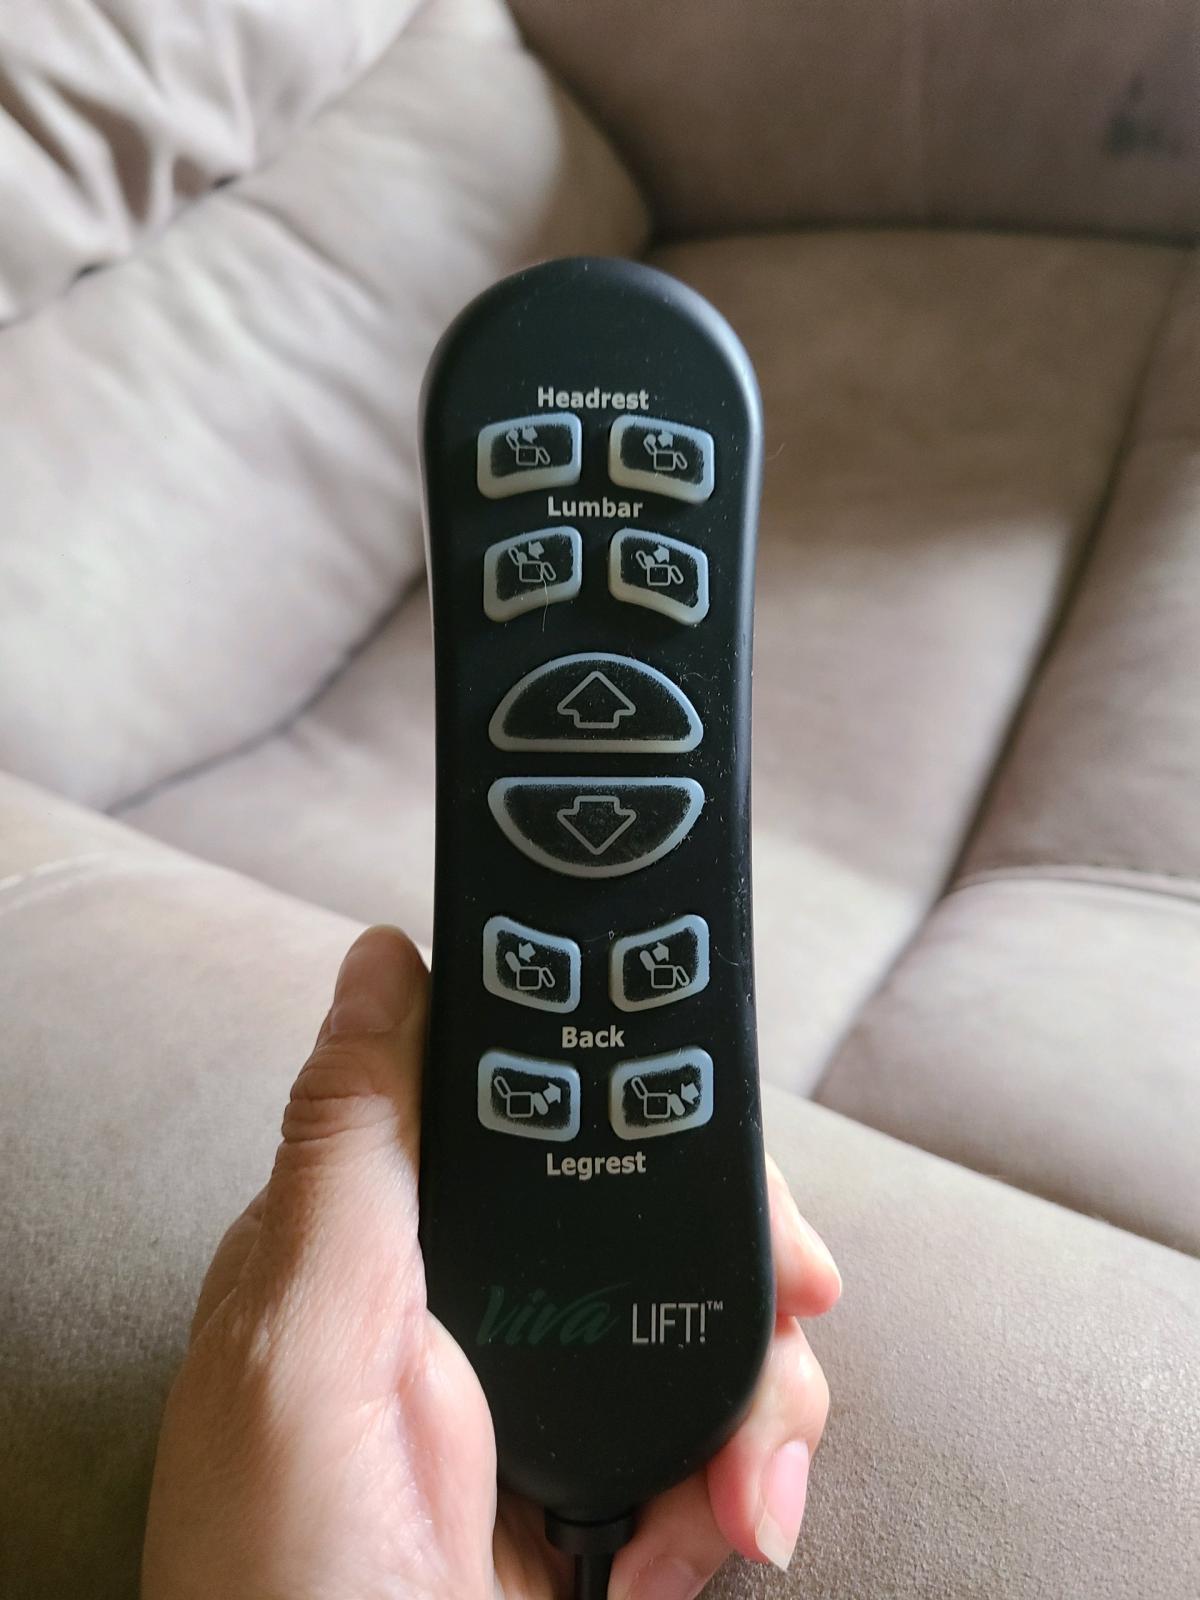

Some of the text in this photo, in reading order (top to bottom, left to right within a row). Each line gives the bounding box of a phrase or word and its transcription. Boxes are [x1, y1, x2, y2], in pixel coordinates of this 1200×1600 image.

[537, 386, 650, 410] Headrest
[547, 496, 643, 518] Lumbar
[561, 1025, 625, 1048] Back
[546, 1151, 647, 1180] Legrest
[476, 1282, 630, 1345] Viva
